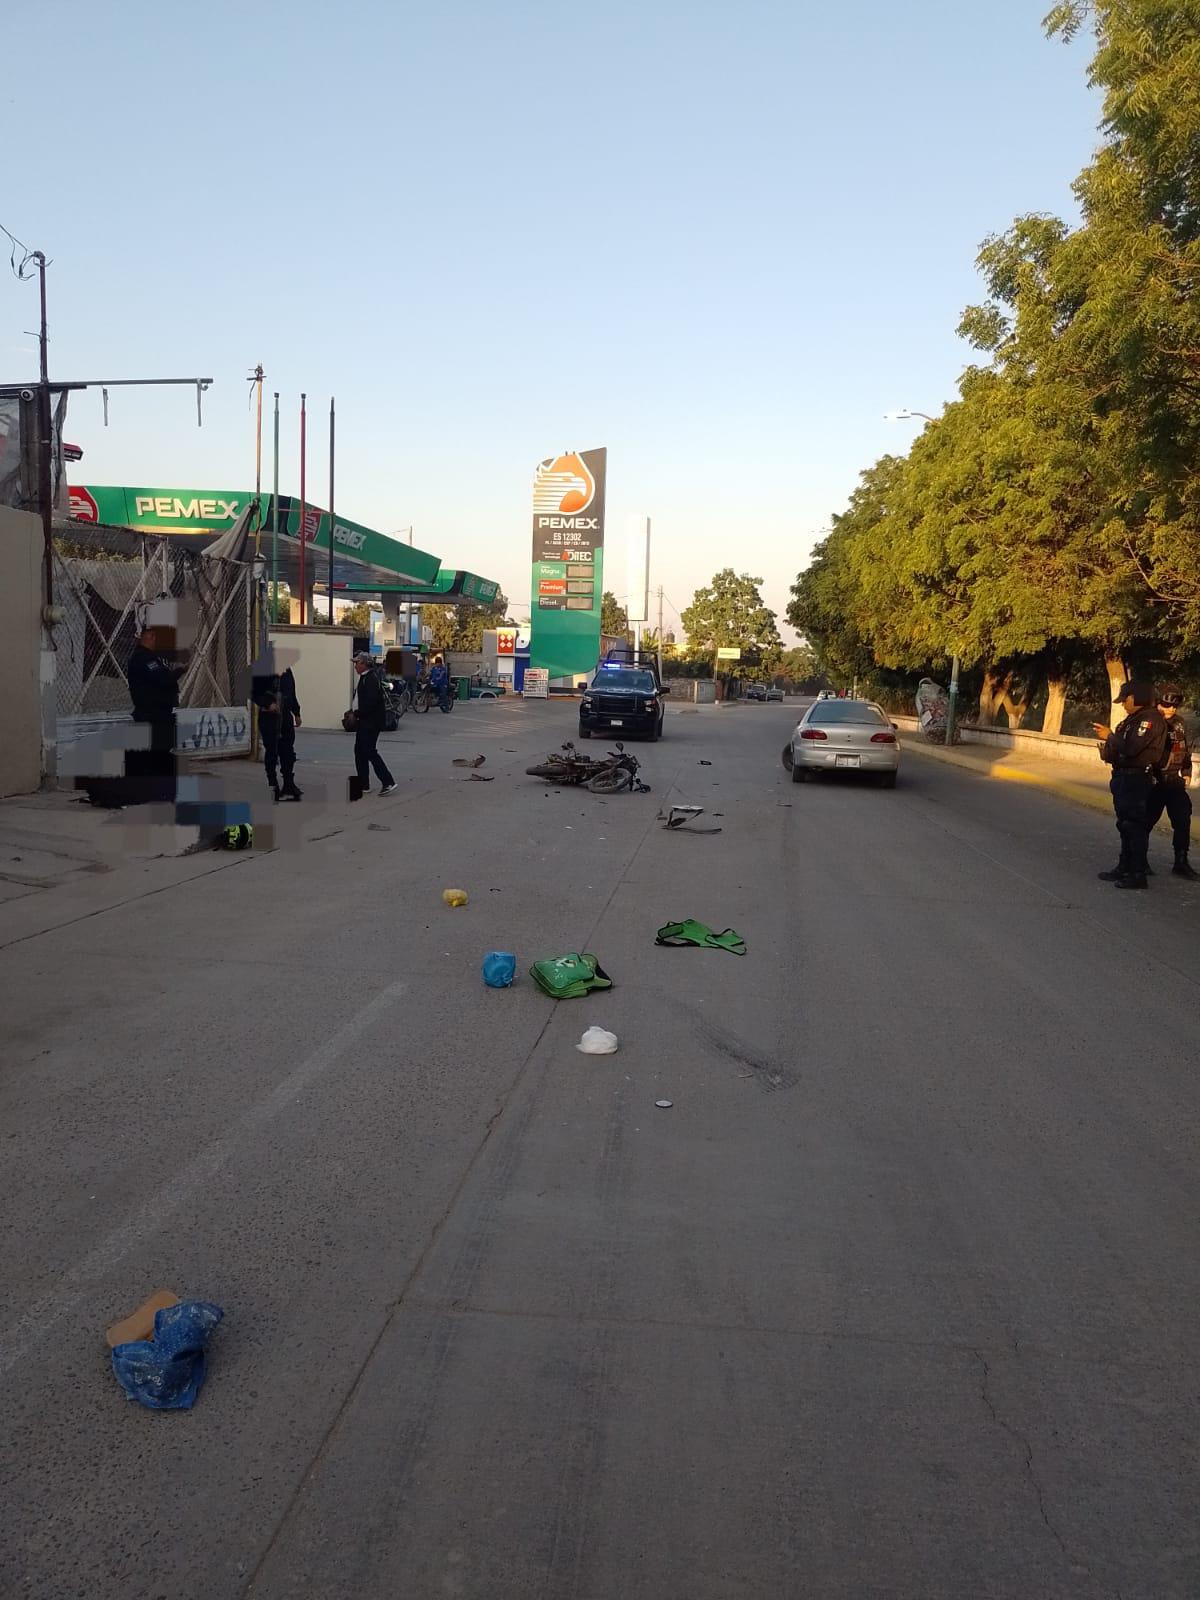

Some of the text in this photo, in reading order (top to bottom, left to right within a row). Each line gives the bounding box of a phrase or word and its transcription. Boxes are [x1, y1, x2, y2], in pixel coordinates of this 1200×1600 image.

[136, 496, 239, 520] PEMEX
[538, 517, 598, 529] PEMEX
[333, 524, 367, 550] PEMEX
[553, 532, 582, 541] ES 12302
